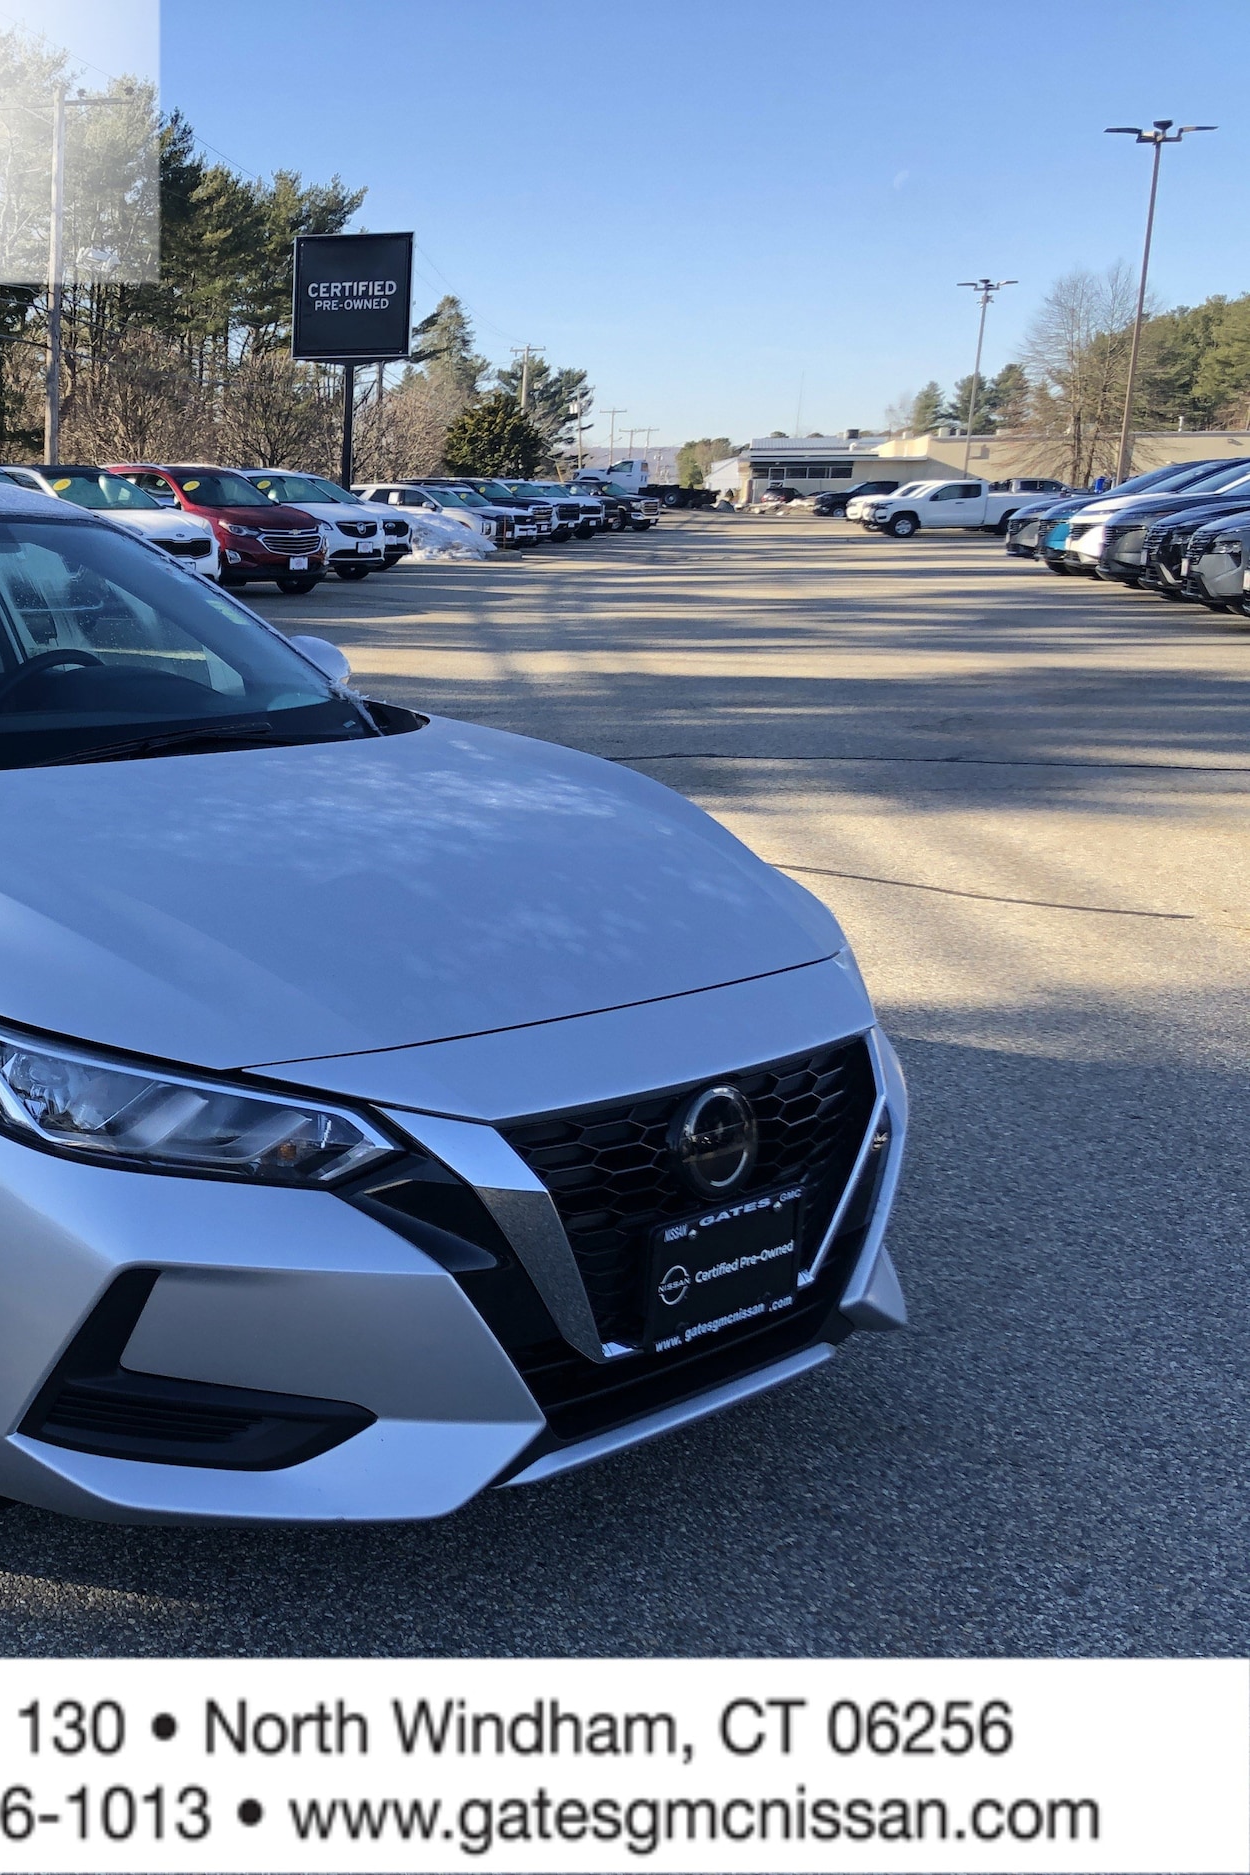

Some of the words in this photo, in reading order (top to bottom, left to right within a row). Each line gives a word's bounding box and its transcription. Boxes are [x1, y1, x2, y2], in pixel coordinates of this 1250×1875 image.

[307, 280, 398, 298] CERTIFIED
[314, 298, 390, 311] PRE-OWNED
[699, 1198, 771, 1227] GATES
[780, 1189, 802, 1202] GMC
[695, 1258, 739, 1283] Certified
[740, 1239, 795, 1269] Pre-Owned
[658, 1277, 691, 1293] NISSAN
[685, 1303, 765, 1342] gatesgmcnissan
